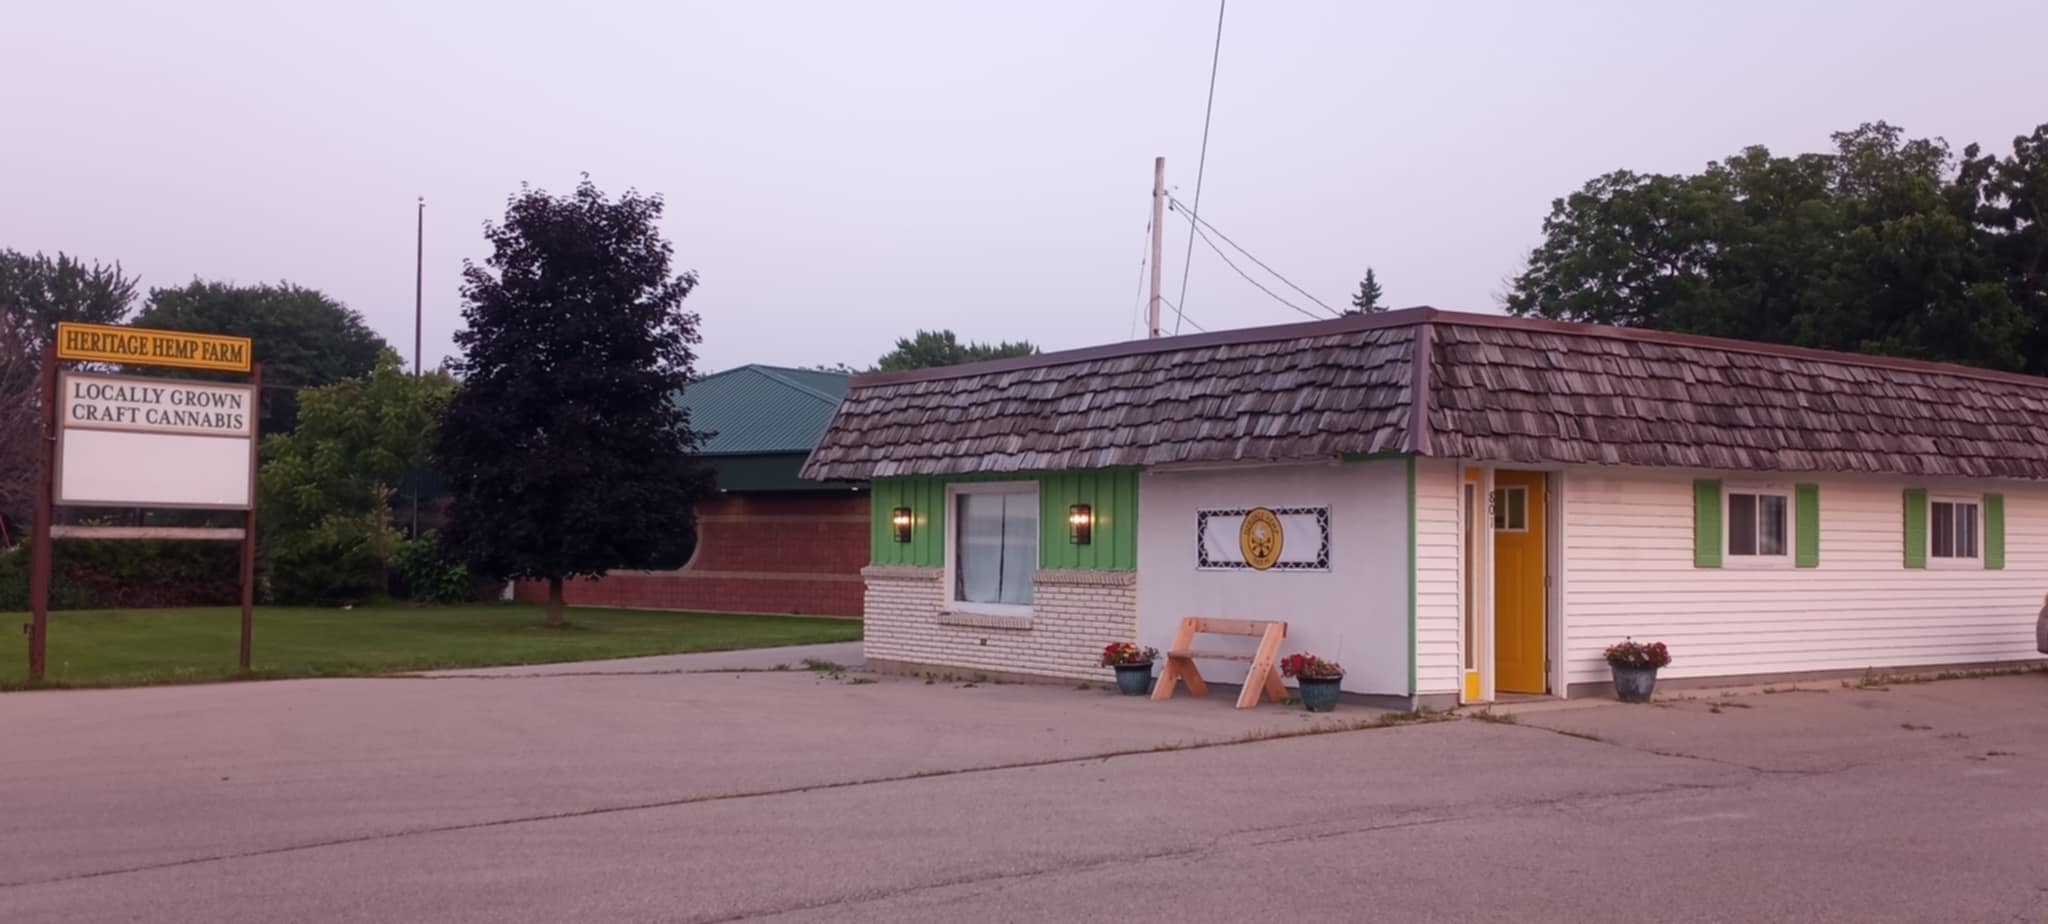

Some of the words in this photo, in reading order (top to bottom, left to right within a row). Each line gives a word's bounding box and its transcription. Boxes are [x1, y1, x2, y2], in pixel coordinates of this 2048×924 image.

[67, 330, 148, 356] HERITAGE
[152, 337, 198, 360] HEMP
[201, 342, 243, 362] FARM
[74, 382, 165, 404] LOCALLY
[170, 389, 242, 409] GROWN
[72, 403, 140, 423] CRAFT
[146, 409, 243, 429] CANNABIS
[1488, 491, 1496, 529] 801
